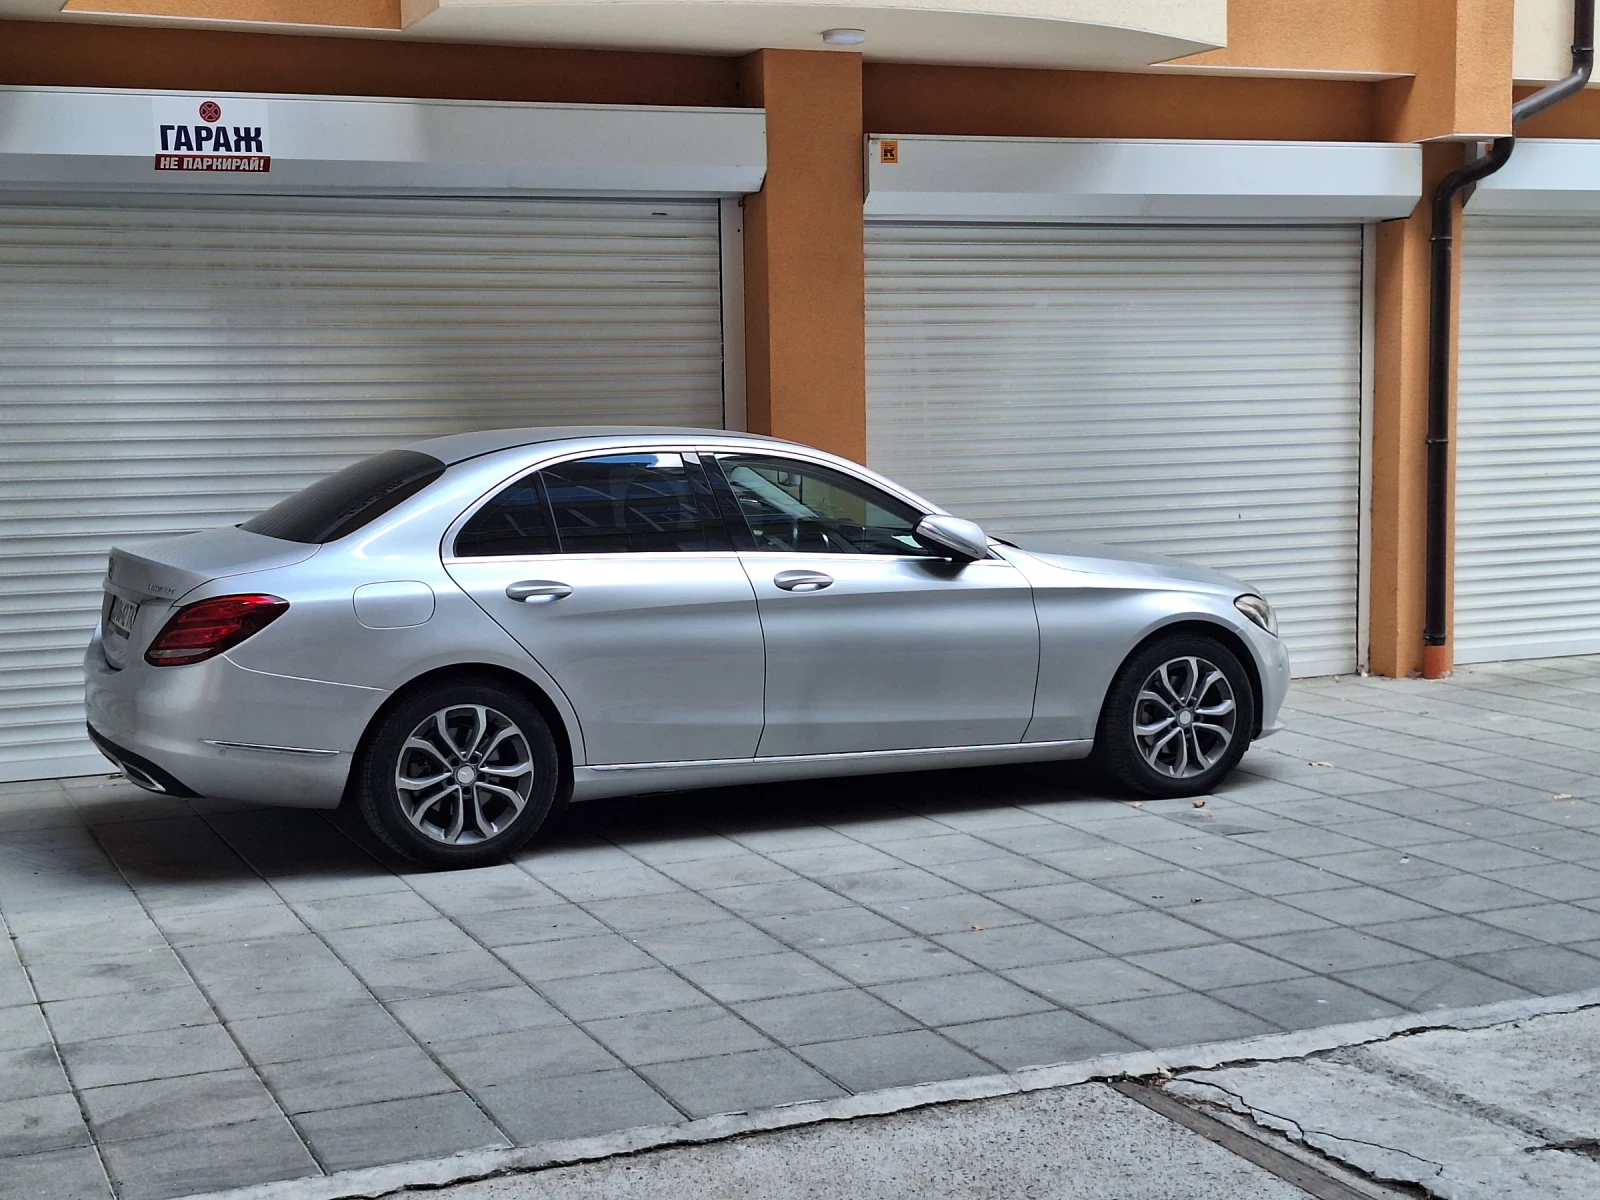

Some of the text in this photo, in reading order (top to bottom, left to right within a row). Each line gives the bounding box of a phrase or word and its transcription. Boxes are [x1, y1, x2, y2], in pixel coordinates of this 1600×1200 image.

[160, 125, 263, 152] ГАРАЖ
[160, 157, 264, 170] НЕ ПАРКИРАЙ!
